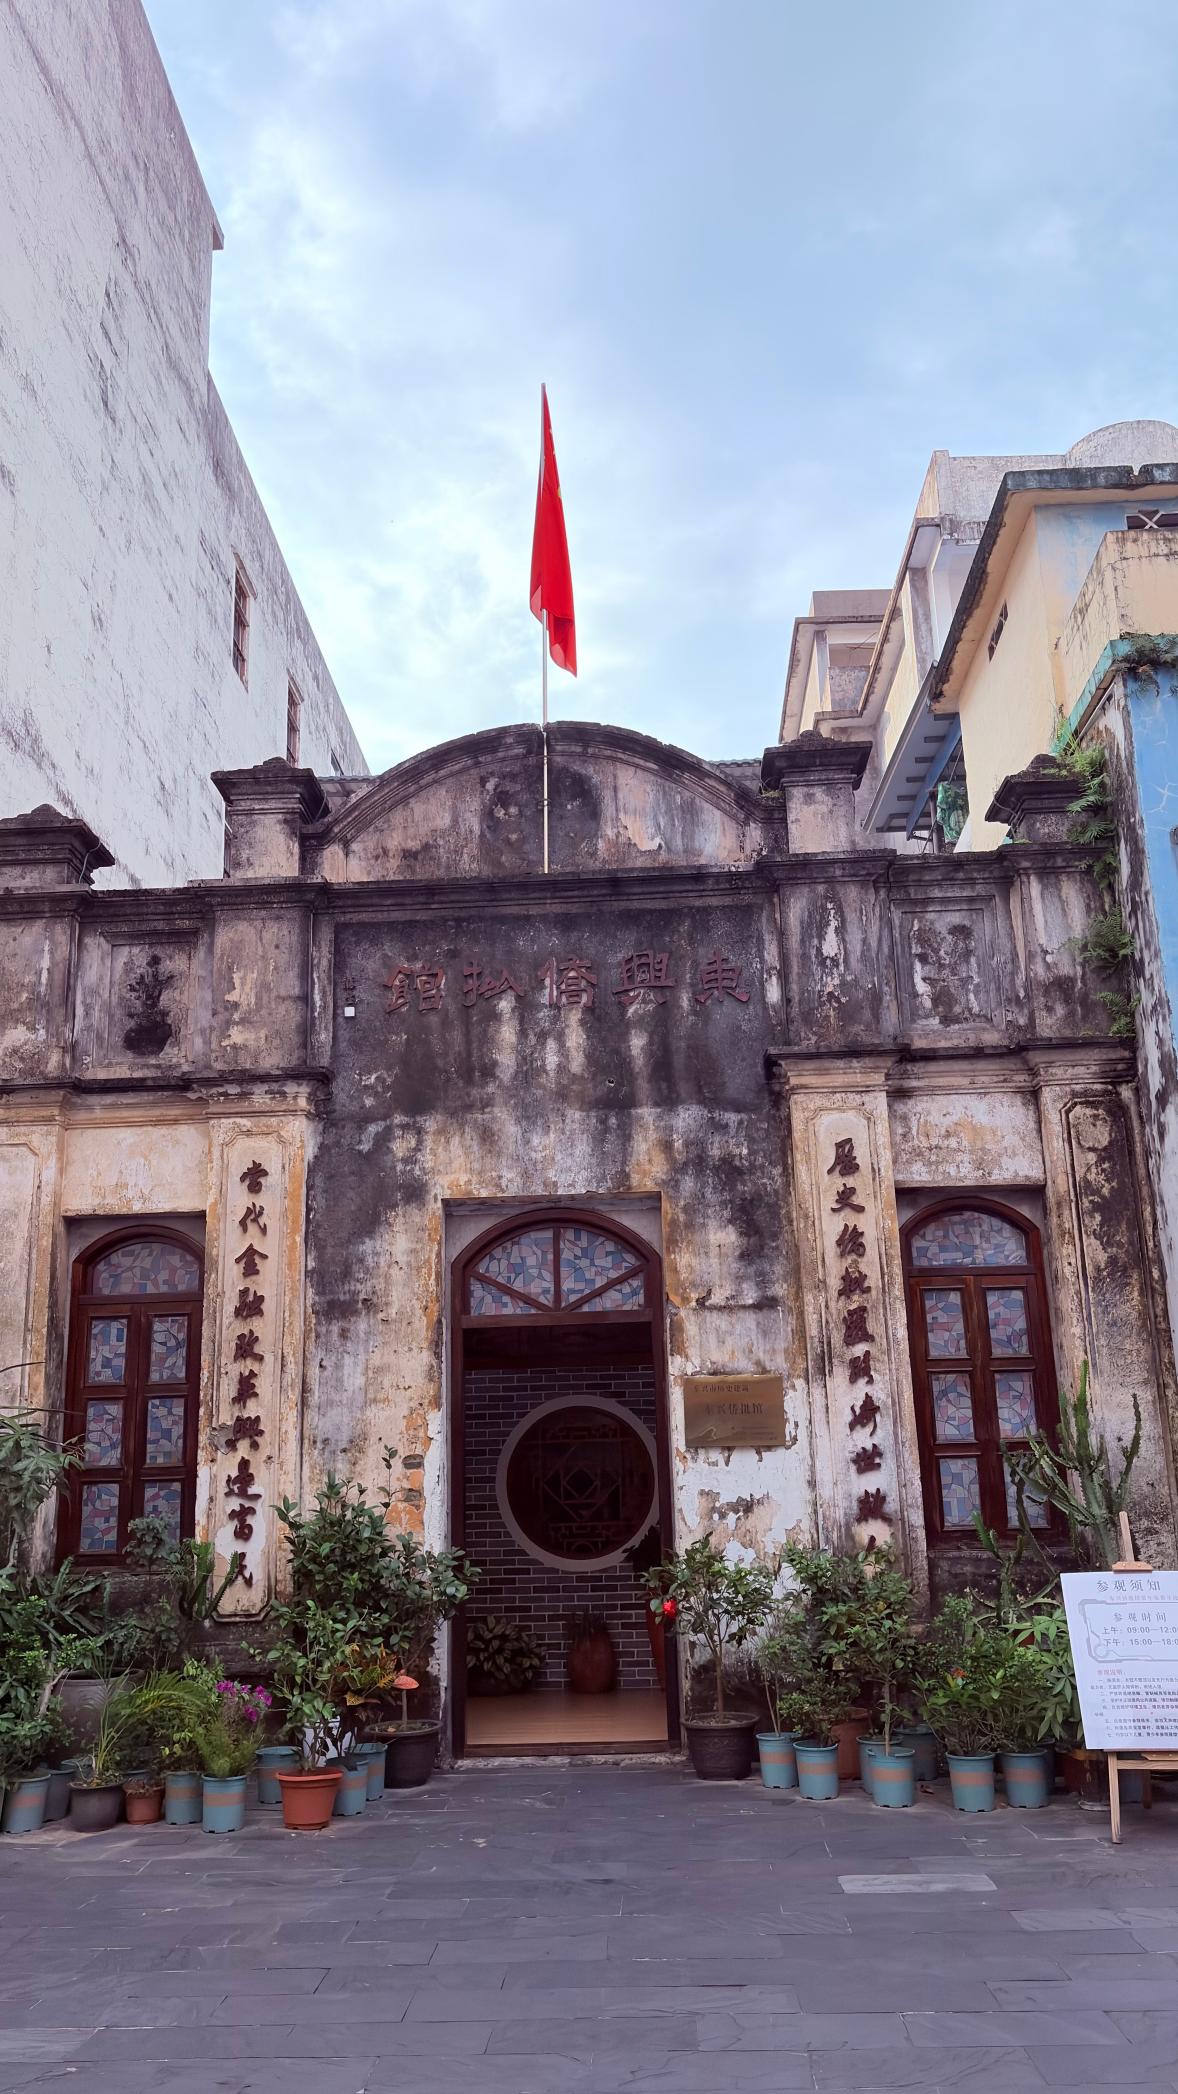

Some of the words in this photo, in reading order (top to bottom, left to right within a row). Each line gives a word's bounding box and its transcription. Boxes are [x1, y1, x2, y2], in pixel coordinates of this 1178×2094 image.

[1097, 1580, 1161, 1592] 参观须知
[1114, 1612, 1167, 1622] 参观时间
